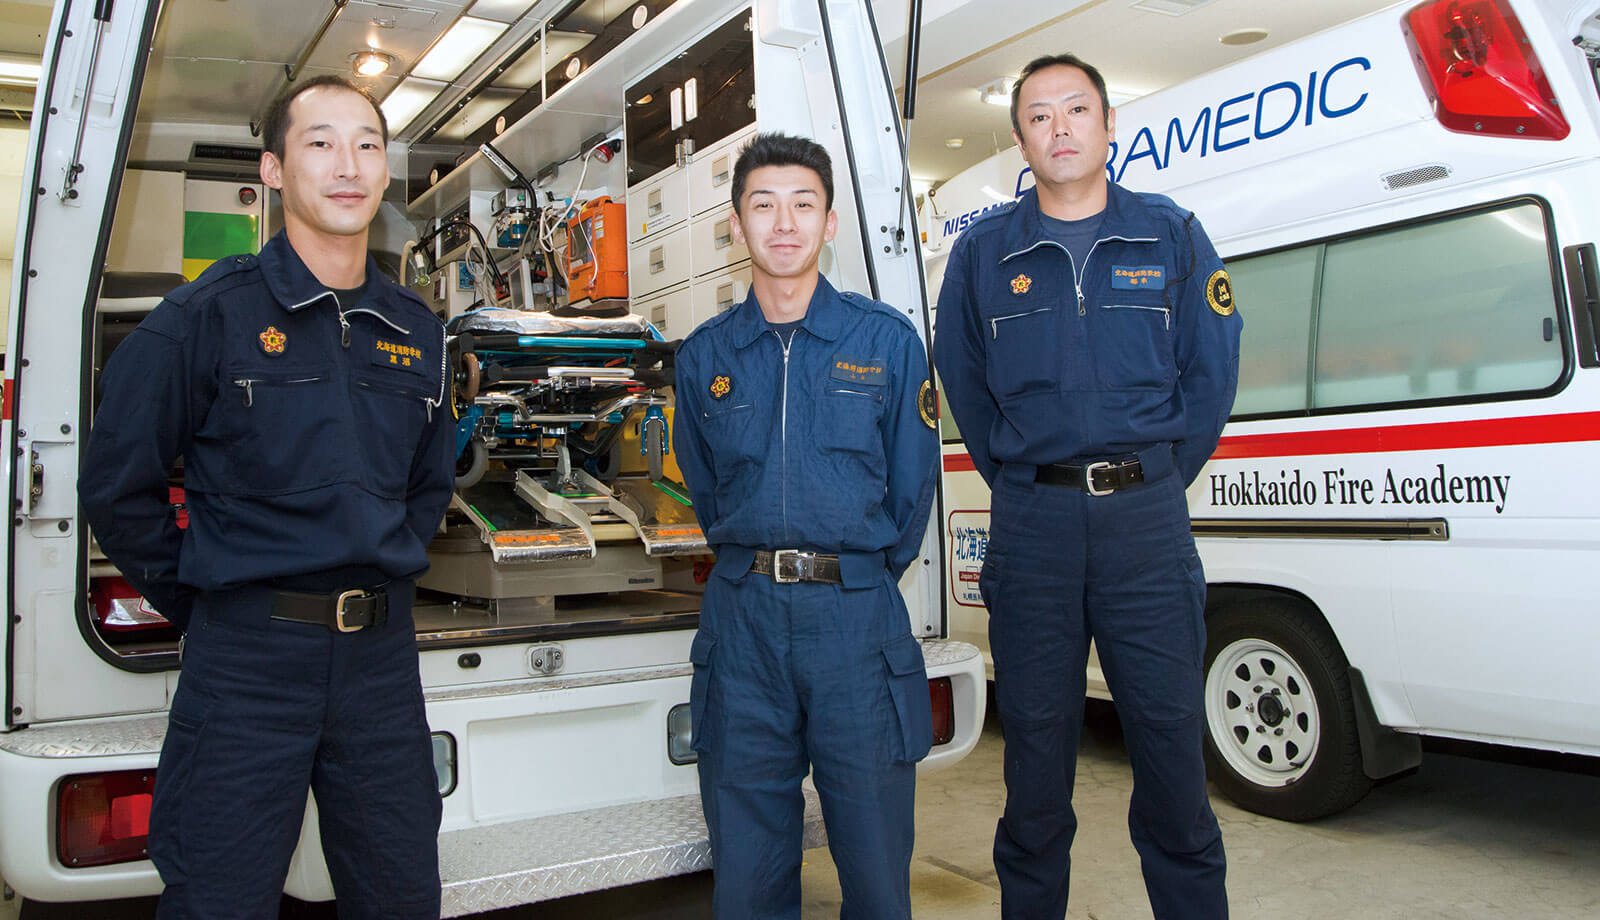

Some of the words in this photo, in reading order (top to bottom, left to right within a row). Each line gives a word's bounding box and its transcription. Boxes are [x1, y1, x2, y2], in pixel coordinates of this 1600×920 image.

[1210, 469, 1317, 506] Hokkaido
[1323, 468, 1374, 505] Fire
[1381, 463, 1511, 513] Academy
